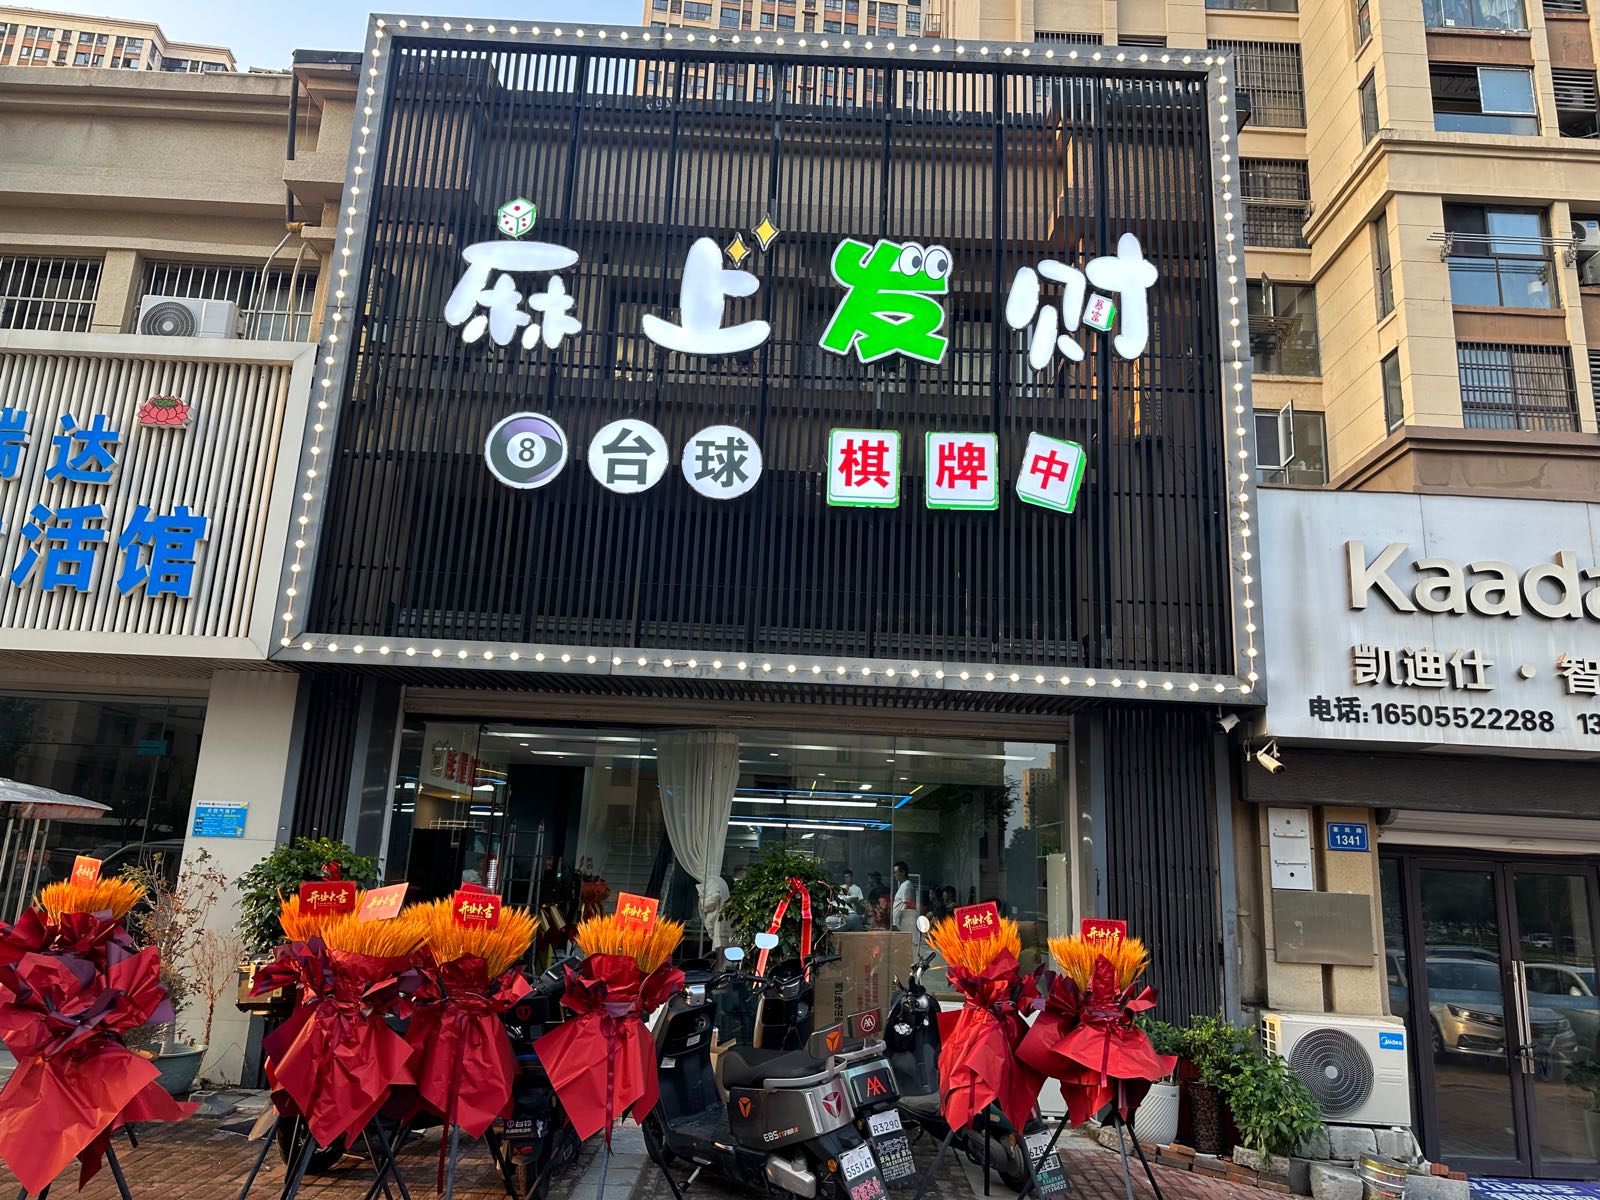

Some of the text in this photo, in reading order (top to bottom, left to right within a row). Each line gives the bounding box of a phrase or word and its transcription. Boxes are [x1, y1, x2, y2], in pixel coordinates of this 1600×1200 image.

[518, 427, 1070, 491] 8 台球 棋牌 中
[0, 502, 209, 598] 活馆
[1336, 834, 1360, 846] 1341
[306, 888, 349, 910] 开业大吉
[458, 900, 495, 922] 开业大吉
[620, 902, 652, 924] 开业大吉
[962, 910, 993, 935] 开业大吉
[845, 1156, 874, 1178] 555147
